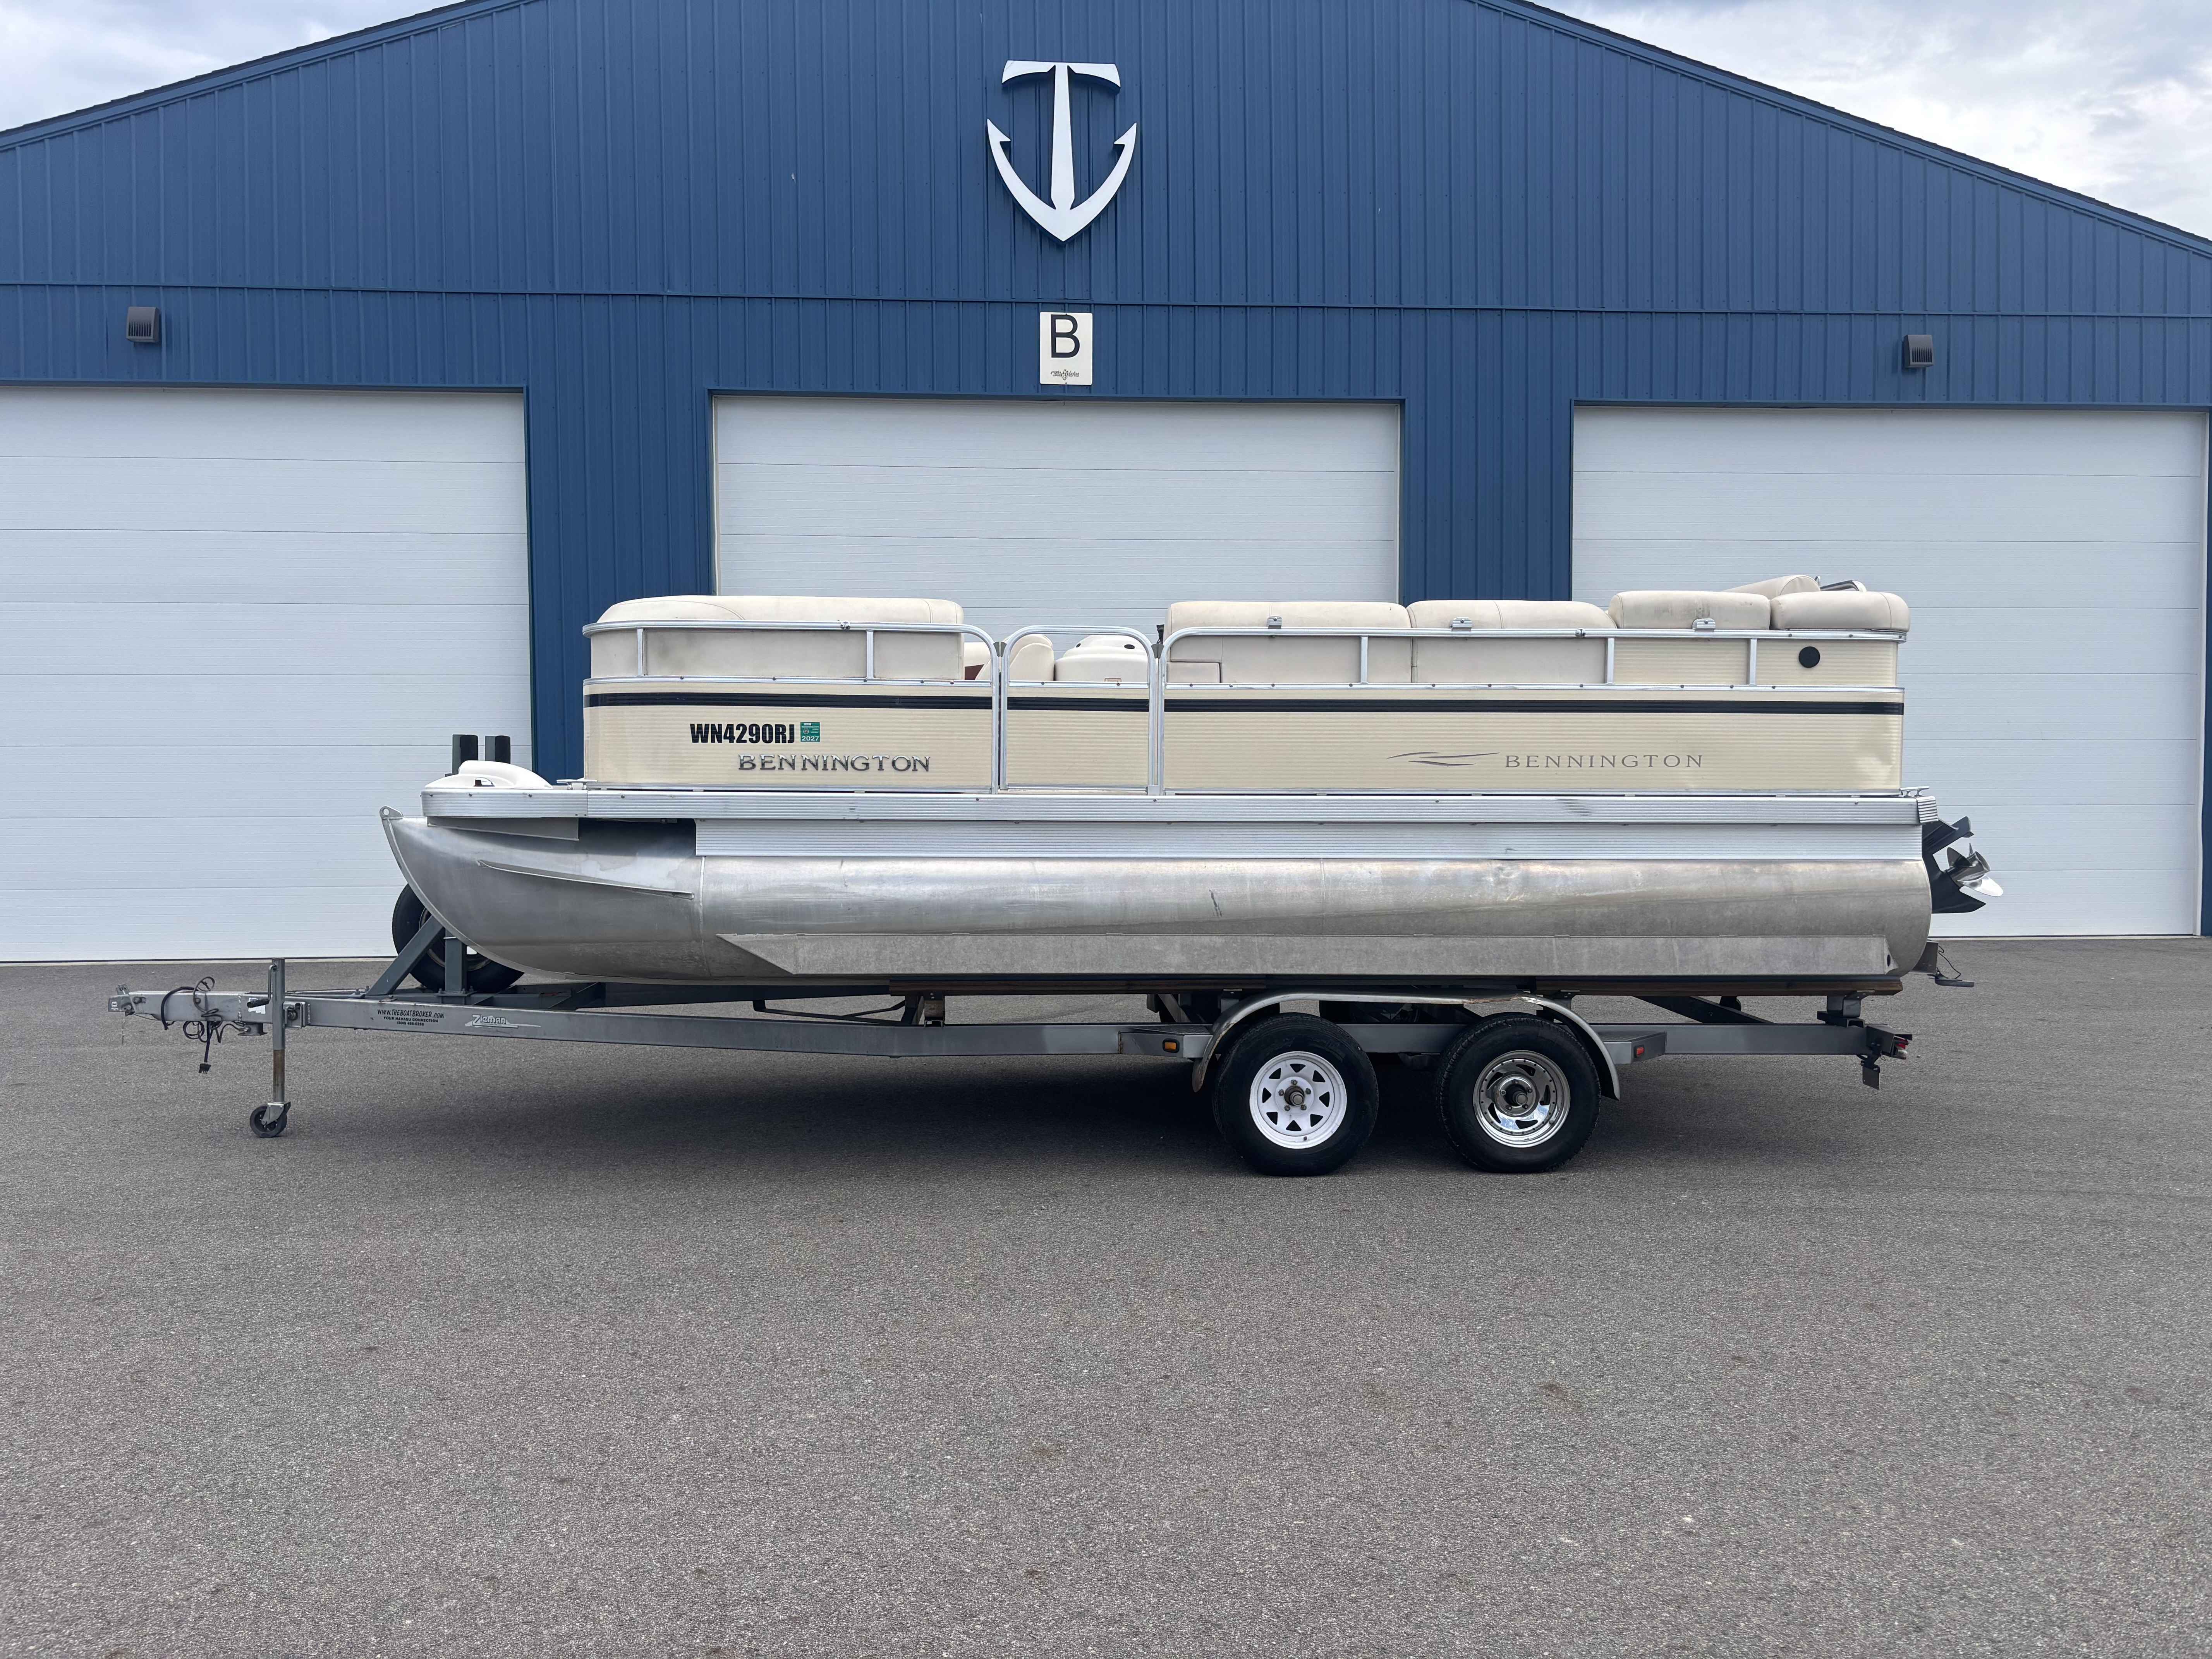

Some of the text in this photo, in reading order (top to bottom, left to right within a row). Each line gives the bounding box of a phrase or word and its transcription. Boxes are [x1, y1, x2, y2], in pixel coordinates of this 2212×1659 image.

[1051, 314, 1080, 358] B
[690, 723, 795, 744] WN4290RJ
[738, 754, 931, 772] BENNINGTON
[1504, 754, 1704, 768] BENNINGTON
[377, 1009, 445, 1018] WWW.THEBOATBROKER.COM
